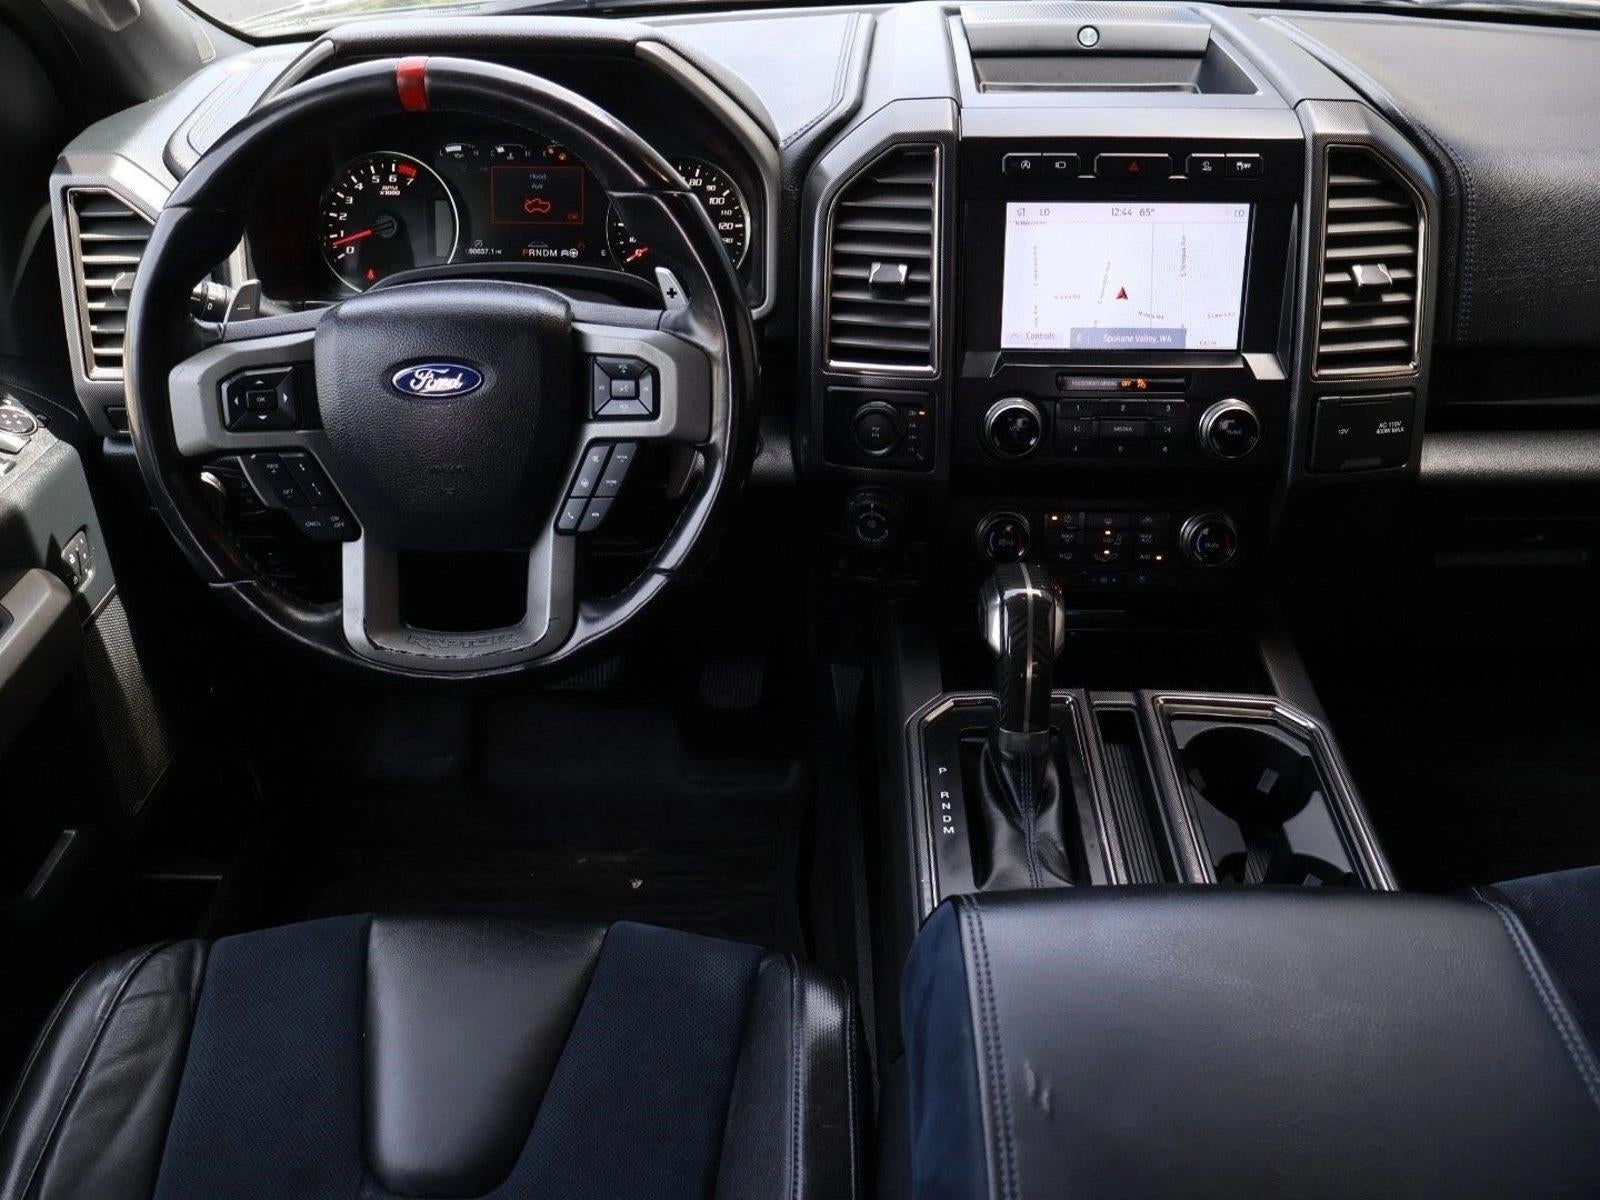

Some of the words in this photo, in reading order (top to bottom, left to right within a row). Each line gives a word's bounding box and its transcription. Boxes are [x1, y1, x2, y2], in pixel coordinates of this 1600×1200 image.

[372, 175, 380, 183] 5
[389, 174, 397, 182] 6
[406, 178, 416, 186] 7
[354, 182, 364, 190] 4
[709, 197, 725, 205] 100
[1040, 207, 1050, 216] LO
[1111, 207, 1132, 217] 12:44
[1234, 208, 1245, 217] LO
[718, 222, 733, 230] 120
[1026, 331, 1055, 341] Controls
[1103, 334, 1133, 344] Spokane
[1135, 334, 1159, 344] Valley,
[1159, 335, 1172, 343] WA
[410, 368, 464, 393] Ford
[943, 826, 955, 834] M
